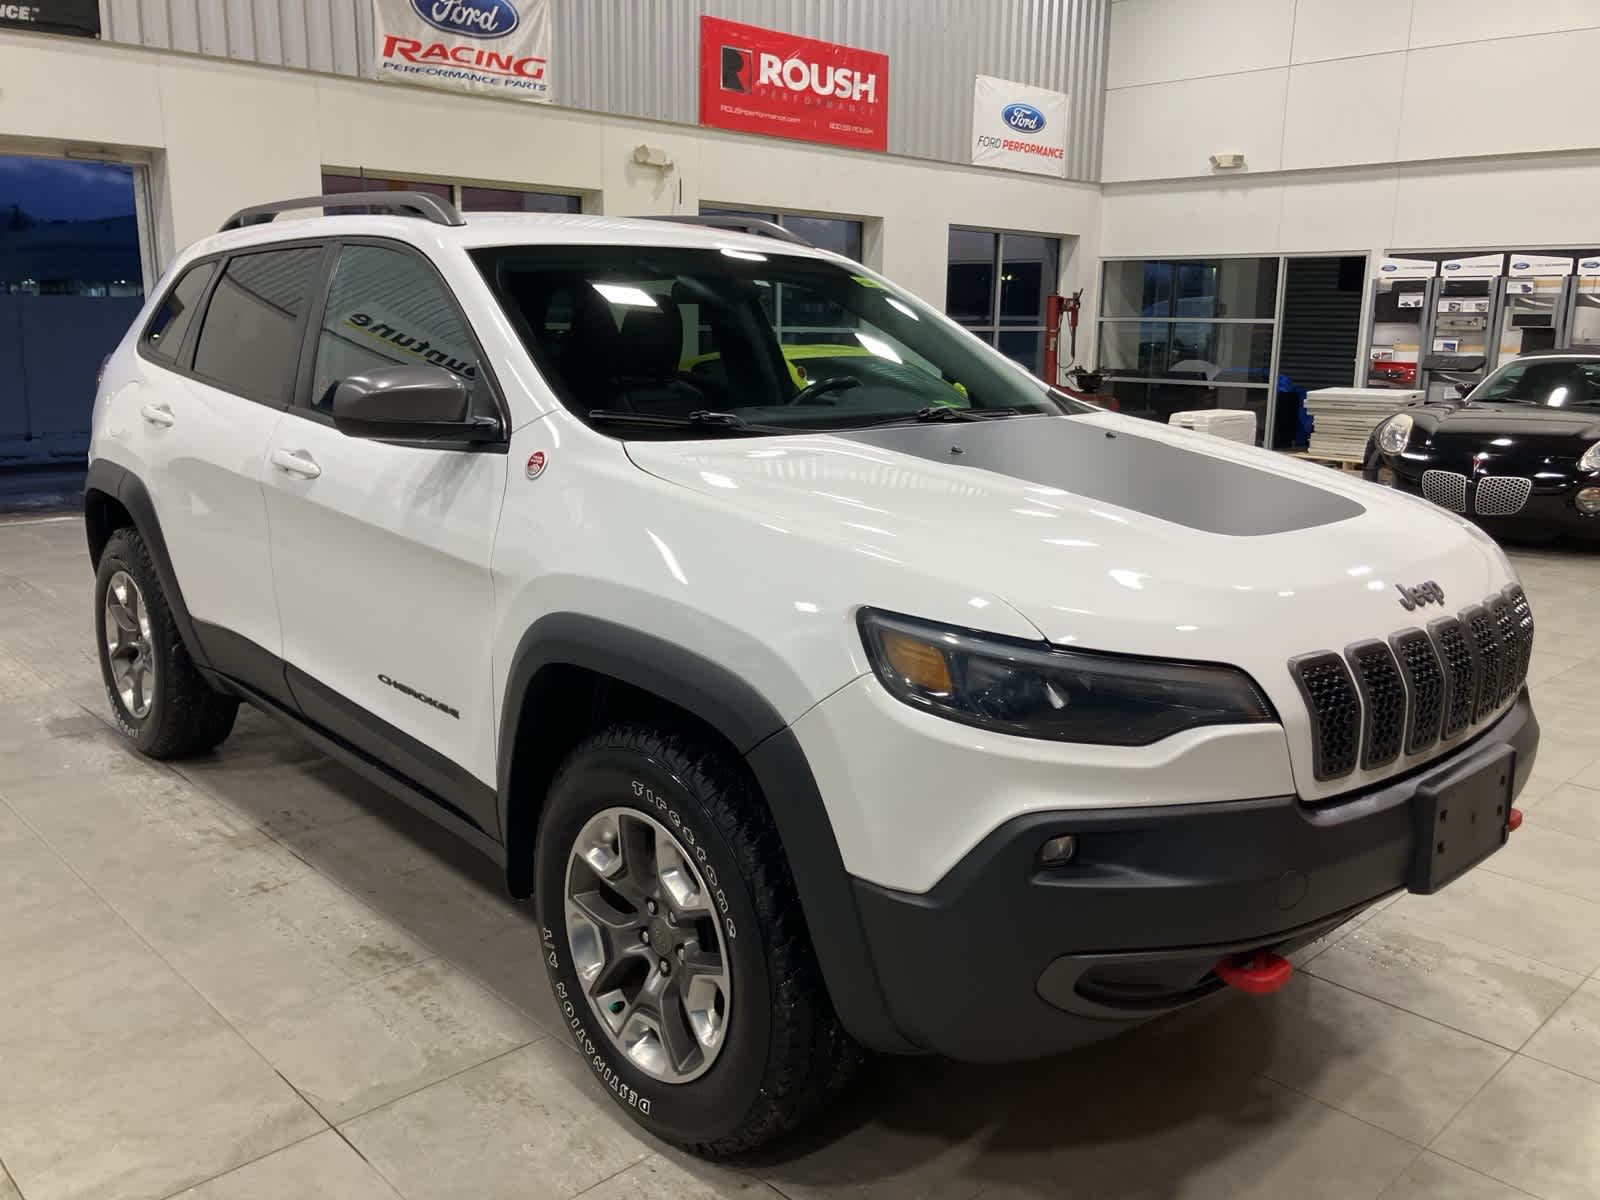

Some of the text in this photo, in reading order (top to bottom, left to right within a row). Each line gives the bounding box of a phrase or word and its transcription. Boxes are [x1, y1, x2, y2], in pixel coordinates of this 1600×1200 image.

[431, 0, 499, 31] Ford
[382, 34, 547, 80] RACING
[383, 61, 548, 92] PERFORMANCE PARTS
[759, 52, 877, 104] ROUSH
[1009, 107, 1039, 129] Ford
[977, 135, 1065, 160] FORD PERFORMANCE
[1395, 580, 1445, 612] Jeep
[377, 673, 460, 720] CHEROKEE
[555, 981, 651, 1116] DESTINATION
